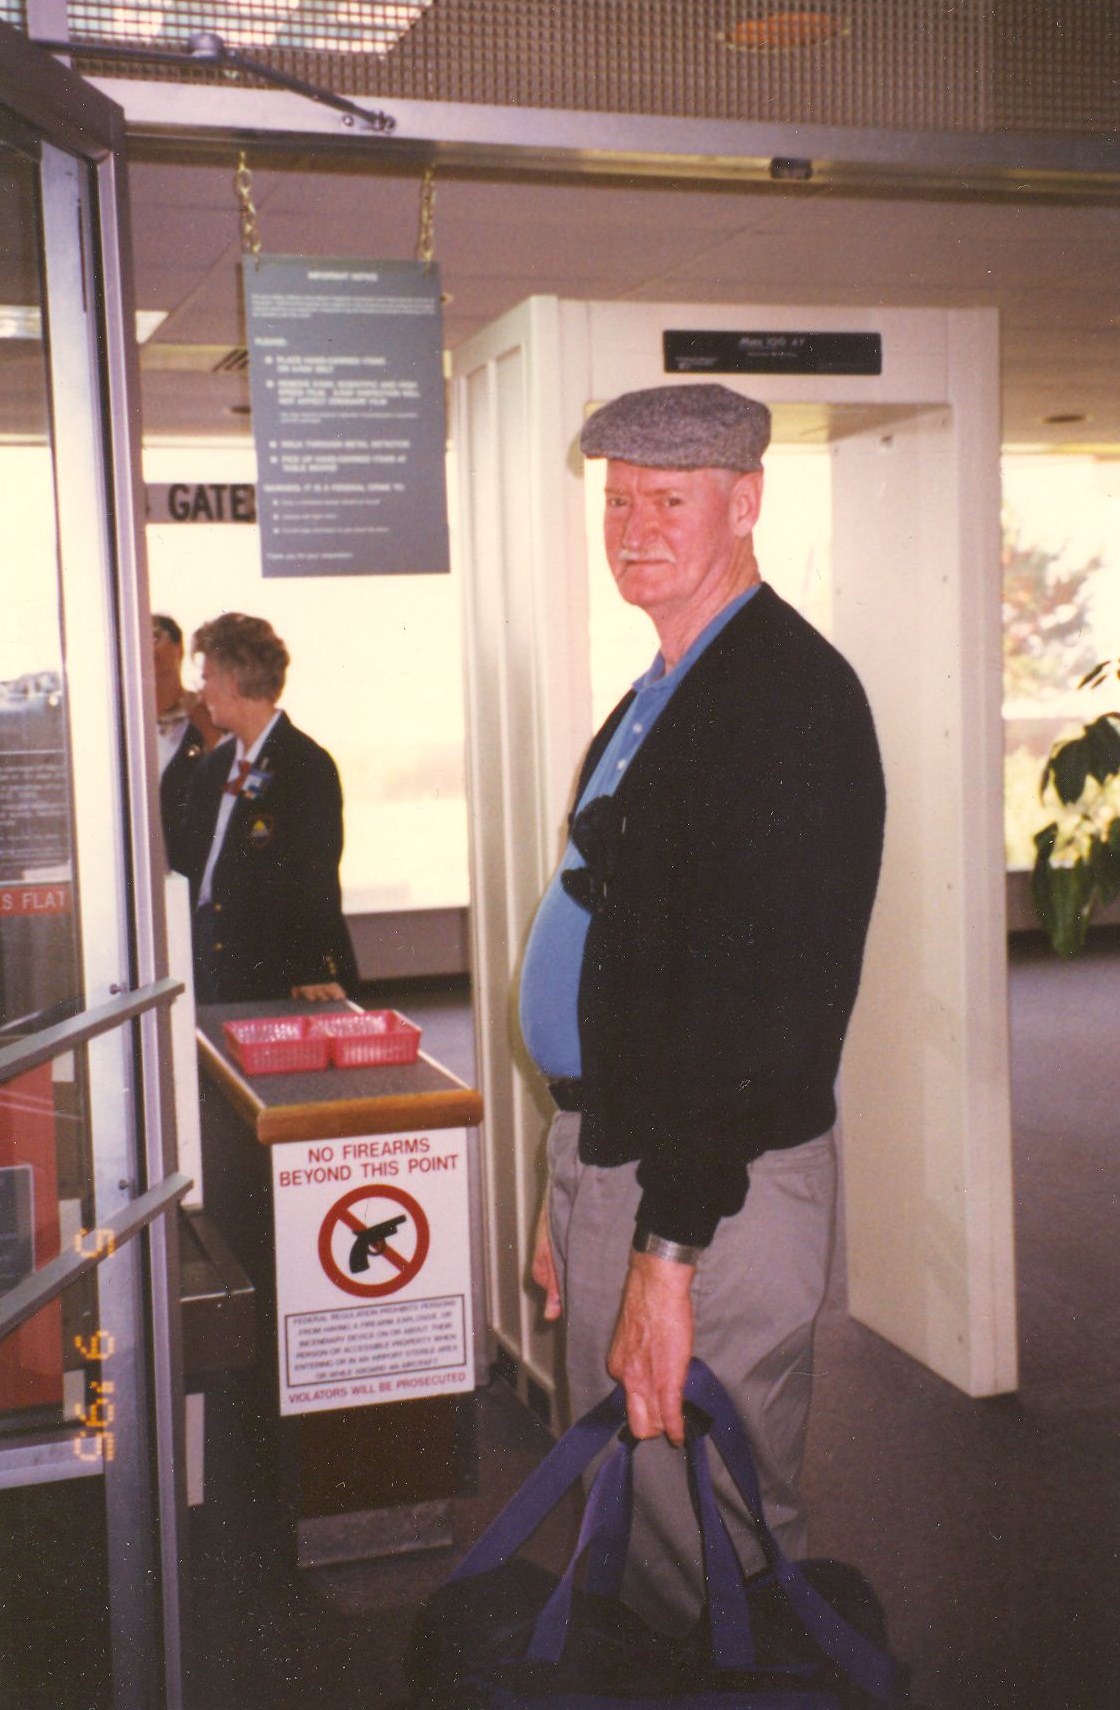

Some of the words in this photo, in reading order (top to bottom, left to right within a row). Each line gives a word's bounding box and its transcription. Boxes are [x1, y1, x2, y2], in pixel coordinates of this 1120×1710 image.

[22, 891, 66, 909] FLAT
[308, 1147, 334, 1163] NO
[342, 1137, 430, 1160] FIREARMS
[279, 1165, 352, 1187] BEYOND
[361, 1160, 399, 1178] THIS
[408, 1154, 459, 1174] POINT
[288, 1387, 348, 1403] VIOLATORS
[351, 1384, 375, 1396] WILL
[379, 1381, 392, 1393] BE
[396, 1371, 466, 1389] PROSECUTED
